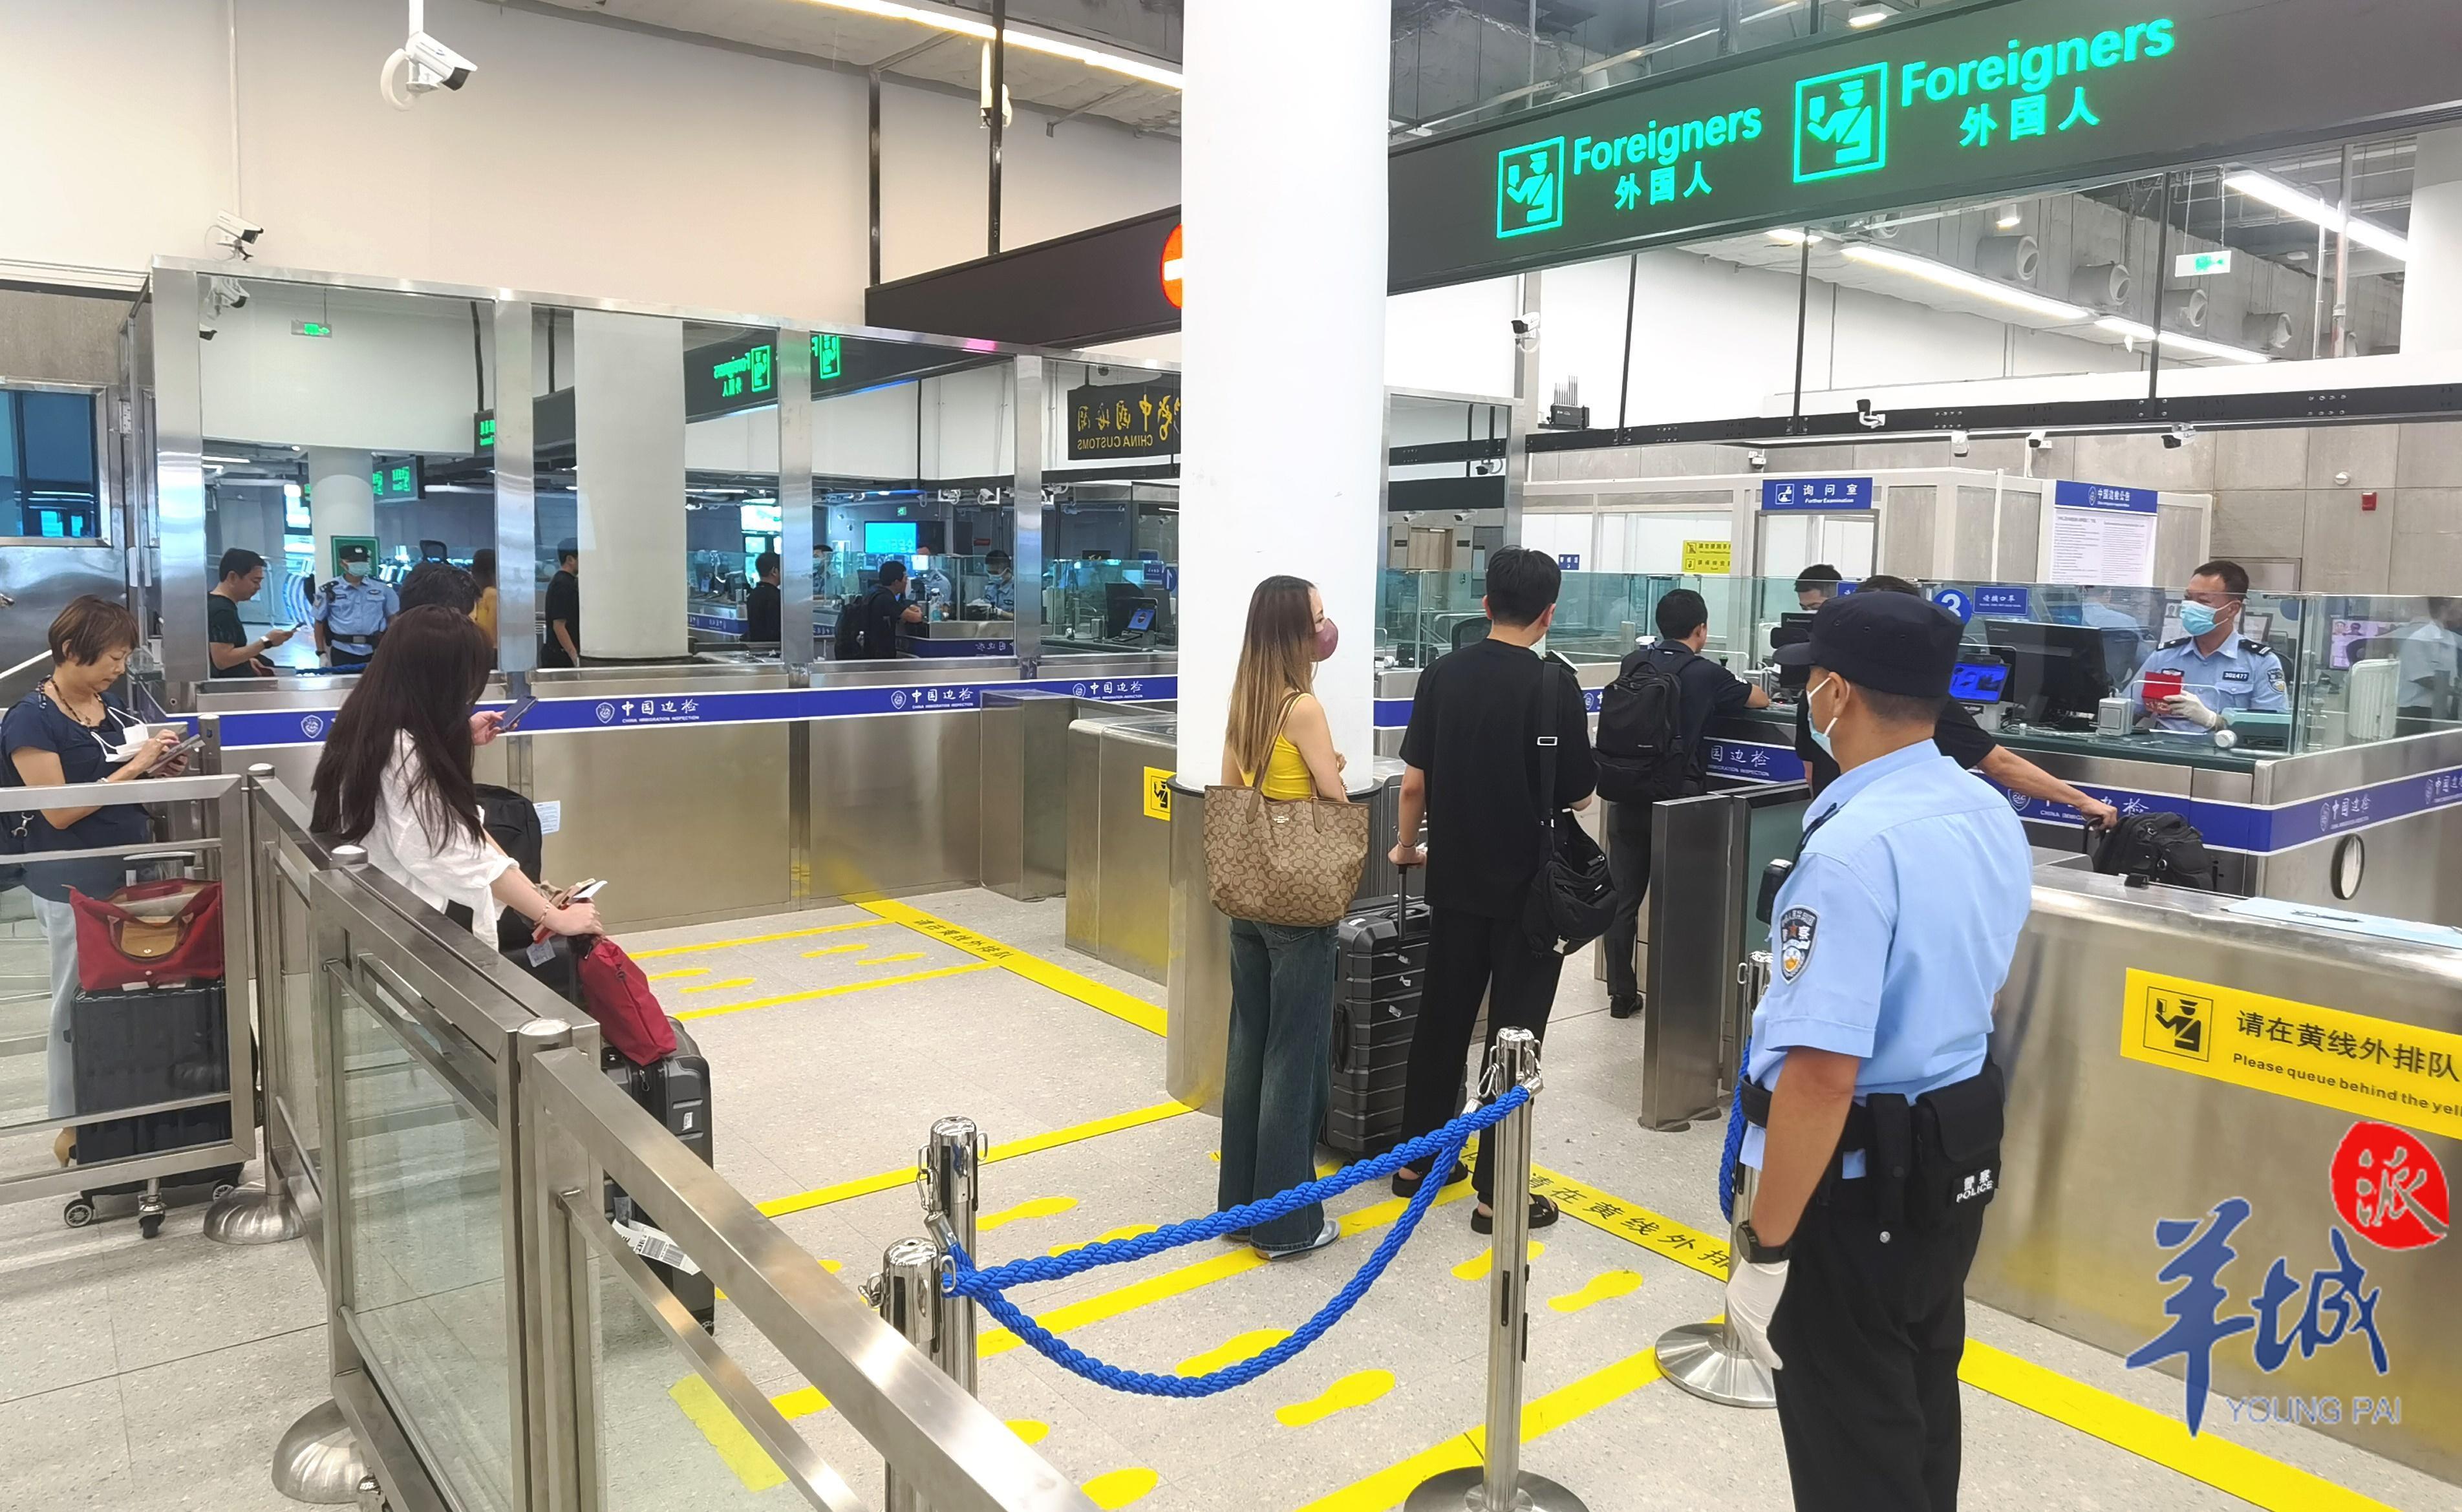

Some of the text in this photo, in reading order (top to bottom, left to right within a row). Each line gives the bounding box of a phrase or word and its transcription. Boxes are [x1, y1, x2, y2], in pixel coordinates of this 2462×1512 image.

[1901, 17, 2175, 107] Foreigners
[1959, 86, 2101, 147] 外国人
[1573, 107, 1762, 175] Foreigners
[1614, 160, 1713, 210] 外国人
[1803, 483, 1857, 496] 询问室
[912, 687, 974, 703] 中国边检
[1089, 681, 1143, 695] 中国边检
[621, 699, 700, 716] 中国边检
[1711, 745, 1770, 767] 国边检
[2331, 793, 2371, 820] 中国边检
[2236, 1010, 2461, 1082] 请在黄线外排队
[2233, 1052, 2284, 1074] Please
[2287, 1067, 2336, 1086] queue
[2339, 1077, 2397, 1102] behind
[2401, 1092, 2429, 1108] the
[1956, 1180, 1994, 1203] POLICE
